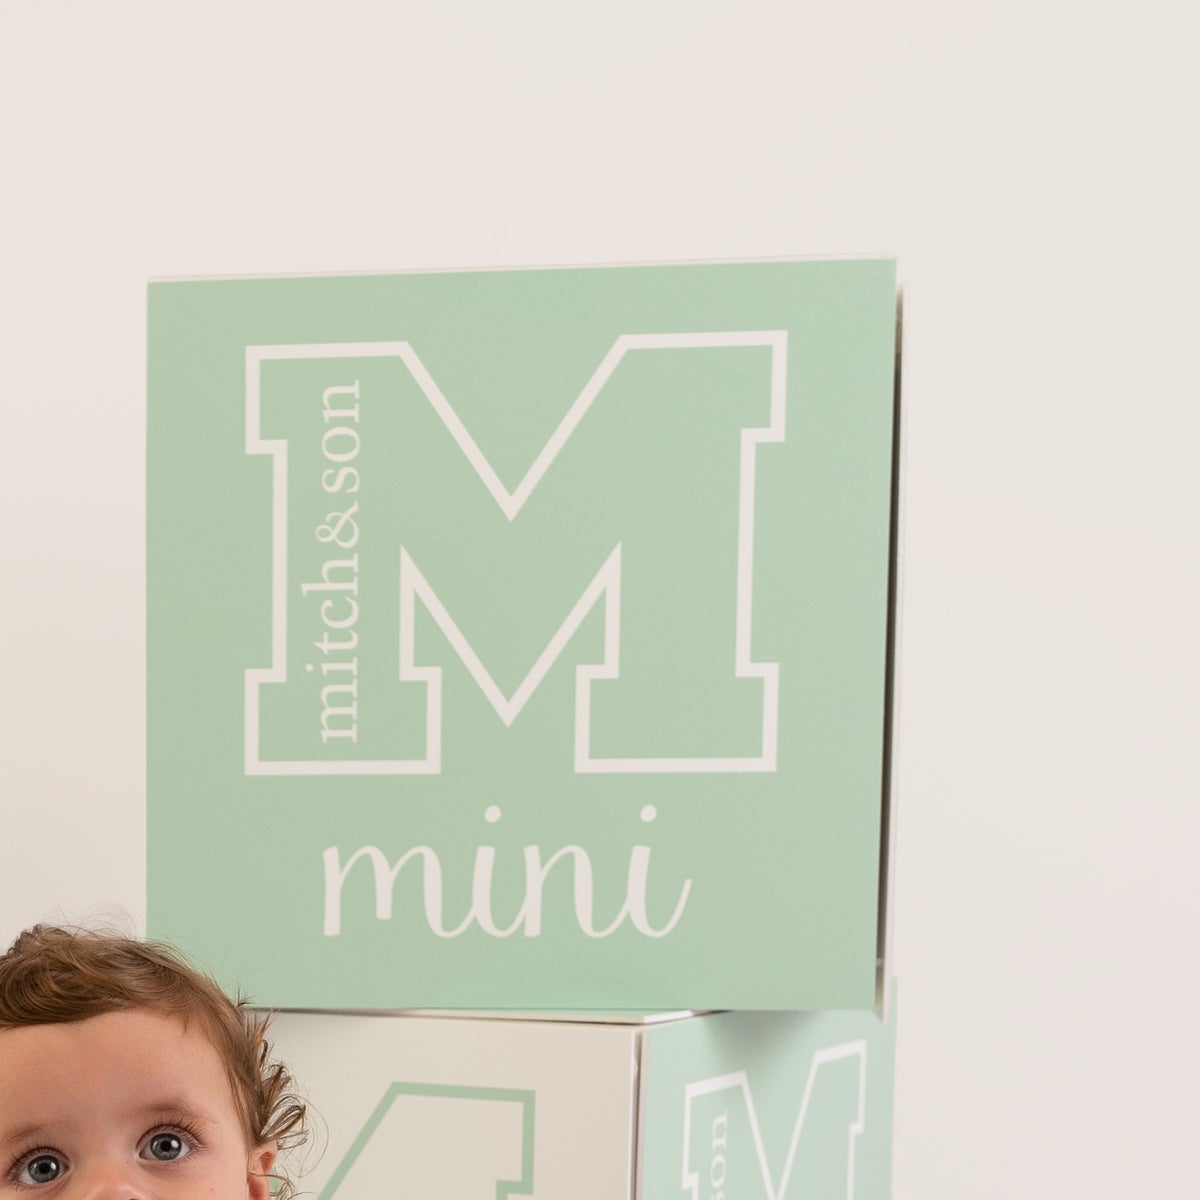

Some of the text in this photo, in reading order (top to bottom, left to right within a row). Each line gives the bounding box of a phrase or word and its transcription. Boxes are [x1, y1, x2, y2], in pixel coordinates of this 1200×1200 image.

[244, 330, 789, 776] M
[300, 378, 360, 745] mitch&son
[321, 804, 694, 939] mini
